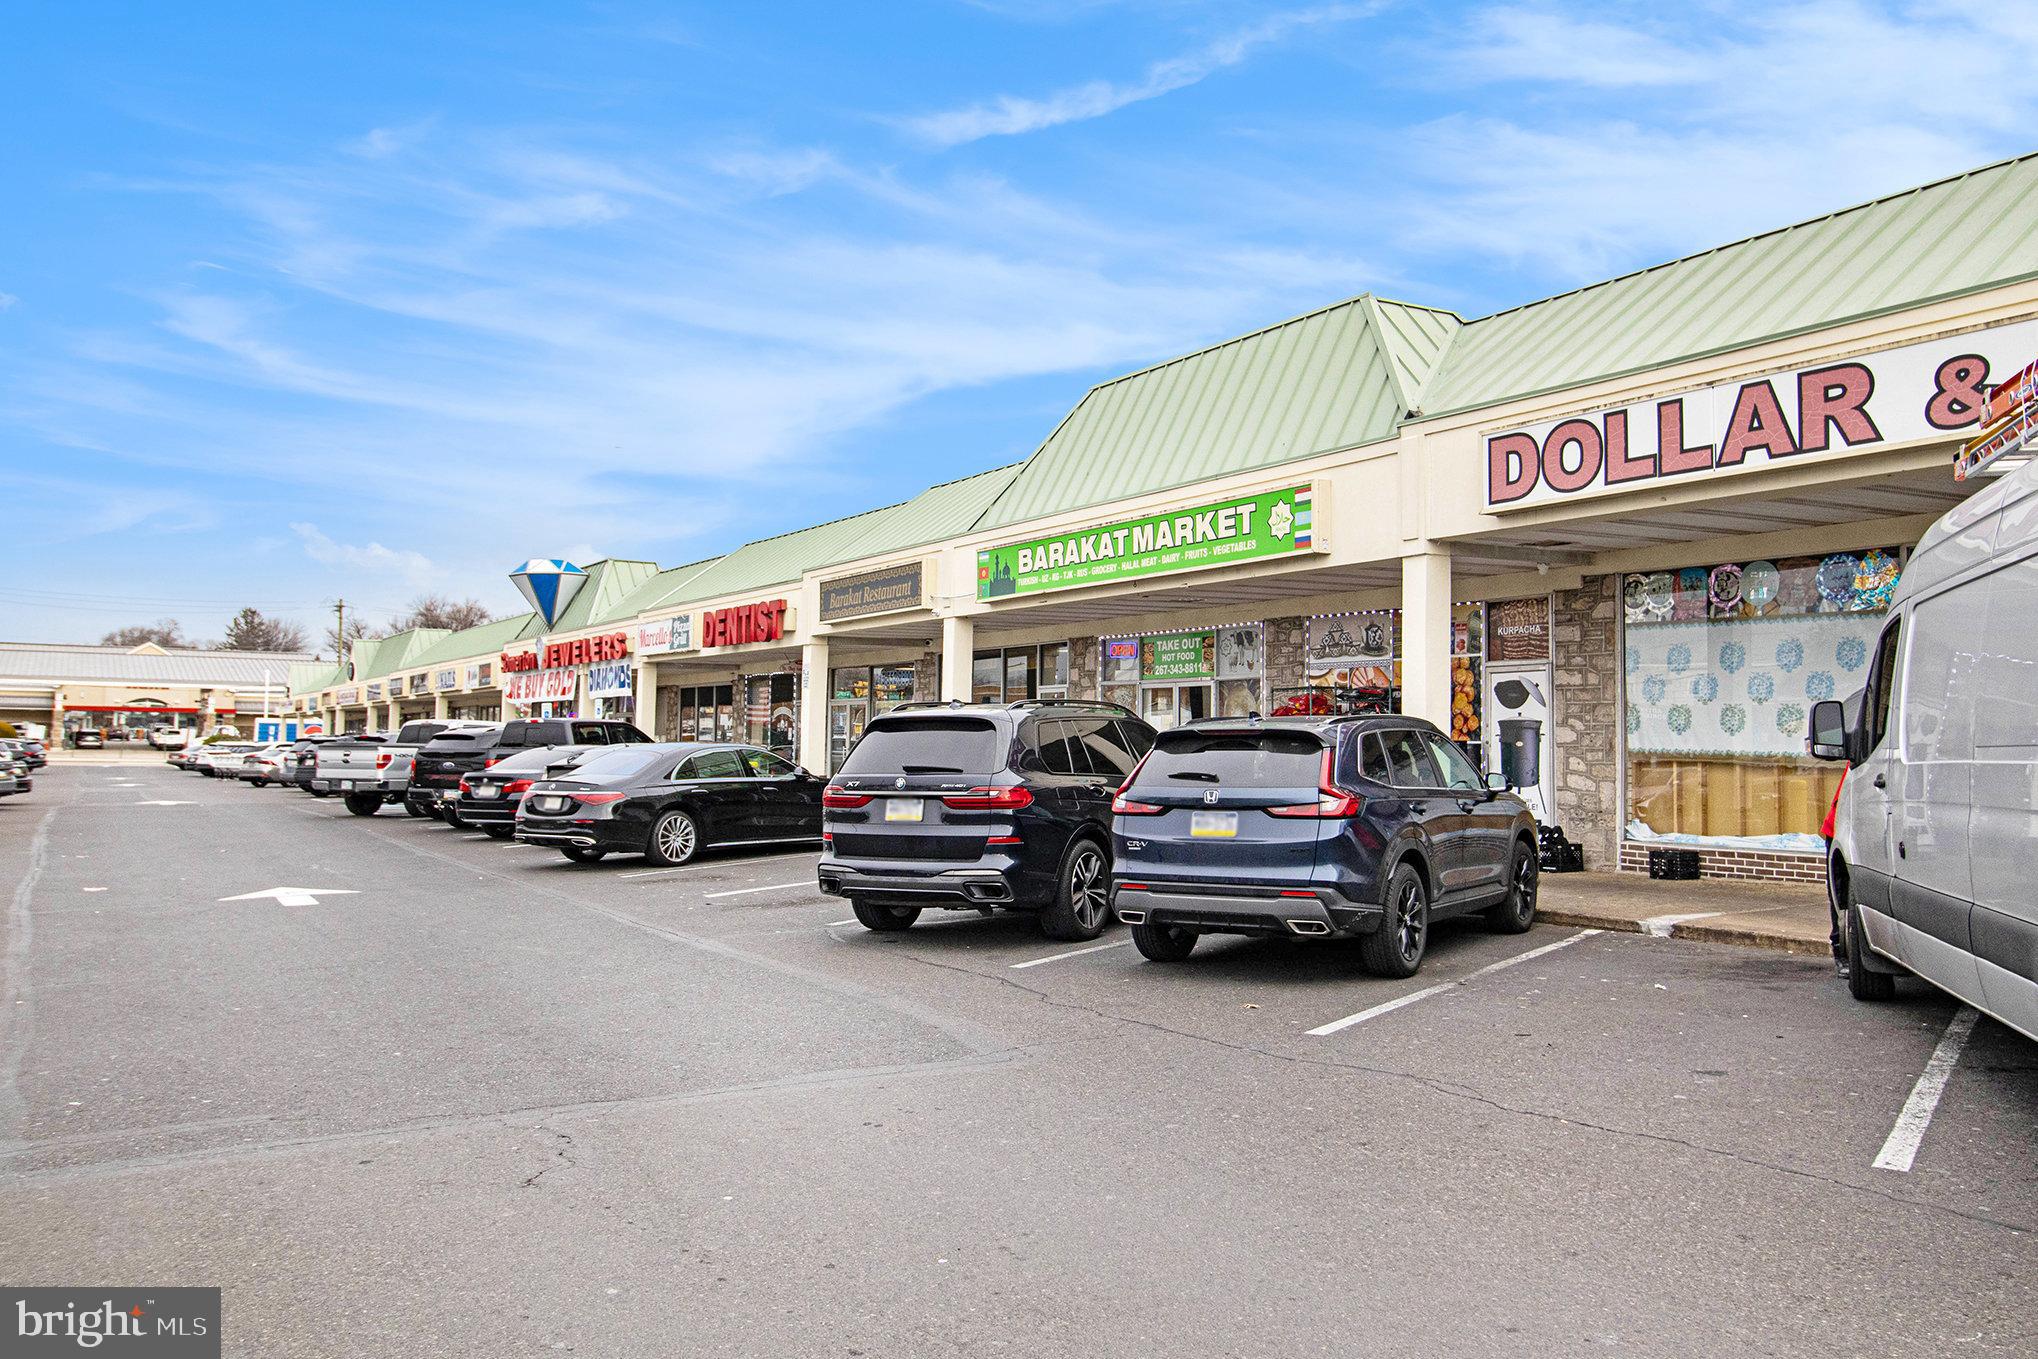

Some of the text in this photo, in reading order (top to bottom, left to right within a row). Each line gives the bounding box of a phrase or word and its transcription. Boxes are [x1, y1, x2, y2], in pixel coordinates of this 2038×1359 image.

[1488, 354, 2001, 505] DOLLAR &
[1017, 502, 1257, 575] BARAKAT MARKET
[1091, 563, 1118, 575] GROCERY
[1121, 561, 1140, 571] HALAL
[1141, 556, 1158, 568] MEAT
[1161, 553, 1180, 564] DAIRY
[1184, 547, 1208, 560] FRUITS
[1212, 539, 1257, 556] VEGETABLES
[829, 580, 913, 609] Barakat Restaurant
[703, 599, 787, 648] DENTIST
[1497, 624, 1541, 636] KURPACHA
[541, 632, 628, 669] JEWELERS
[1111, 644, 1135, 656] OPEN
[1157, 637, 1201, 652] TAKE OUT
[1161, 651, 1195, 662] HOT FOOD
[588, 664, 632, 692] DIAMONDS
[1155, 662, 1203, 676] 267-343-8811
[506, 674, 523, 699] WE
[525, 673, 545, 698] BUY
[546, 669, 575, 697] GOLD
